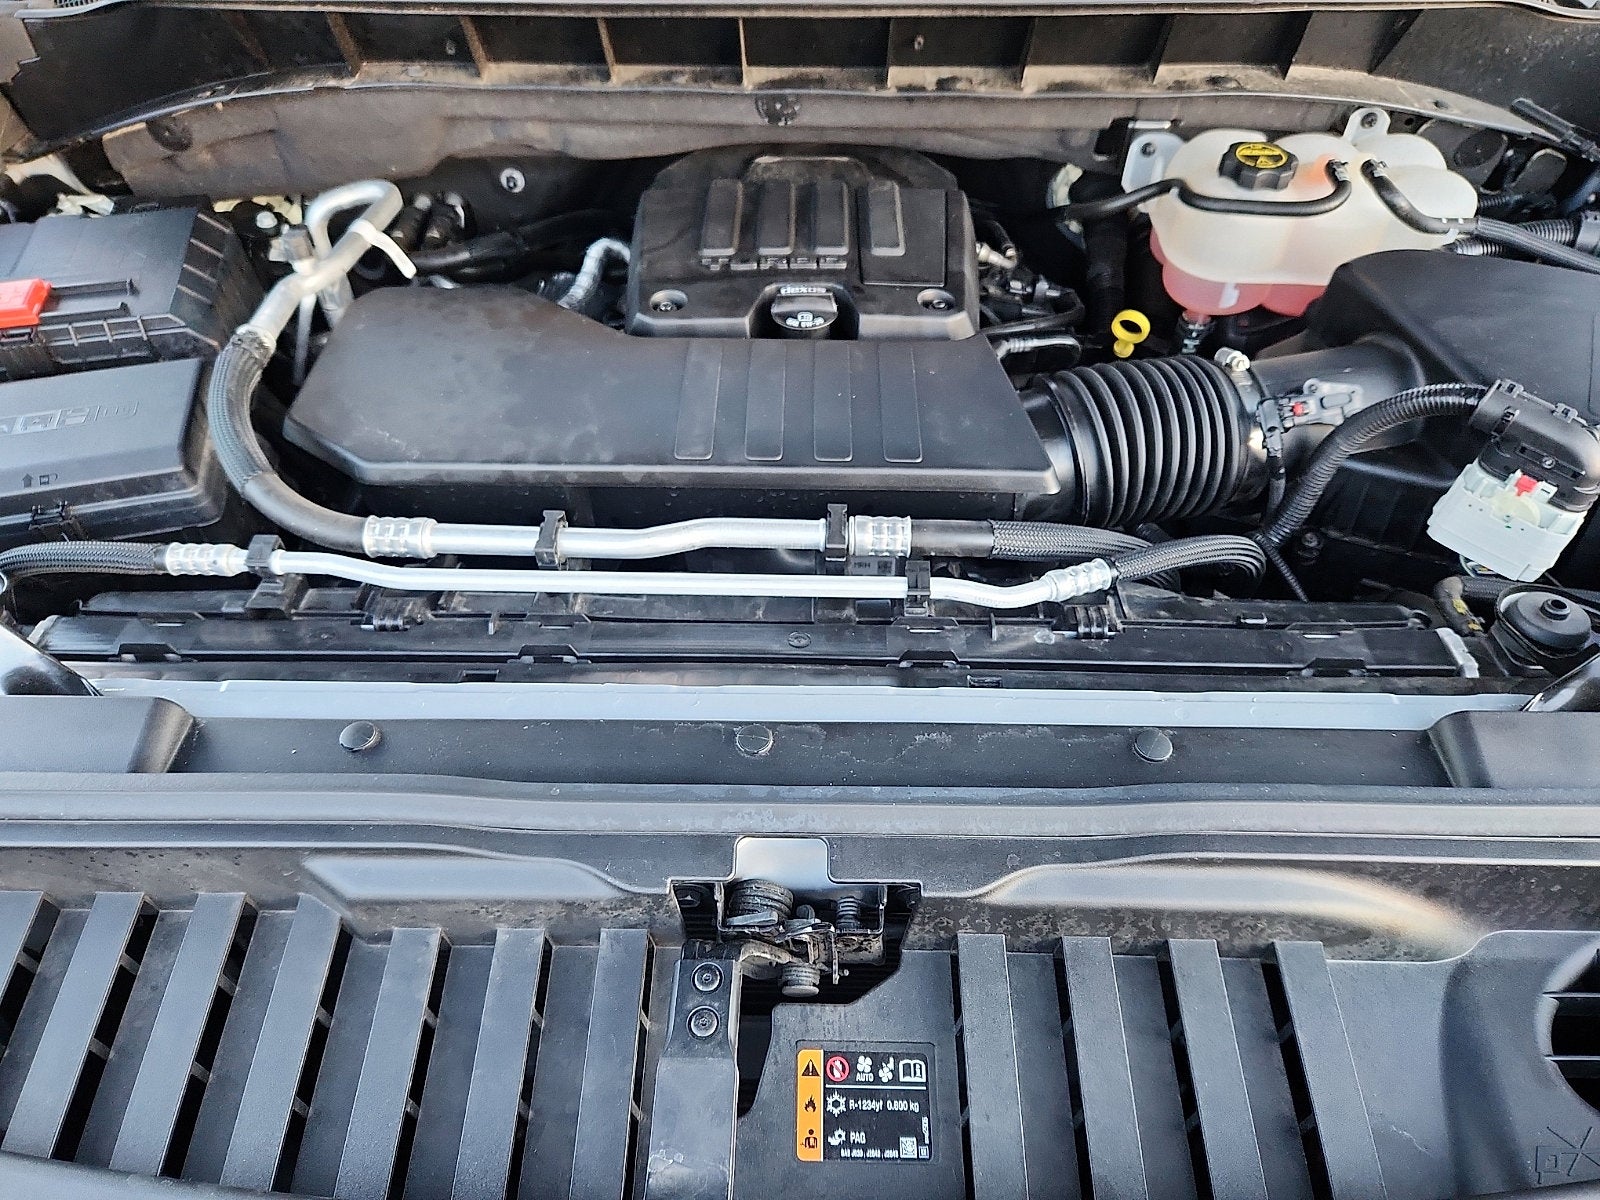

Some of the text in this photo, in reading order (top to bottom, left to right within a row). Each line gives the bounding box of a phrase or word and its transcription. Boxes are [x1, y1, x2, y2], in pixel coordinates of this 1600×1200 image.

[855, 1073, 874, 1082] AUTO
[849, 1099, 883, 1112] R-1234yf
[909, 1099, 920, 1113] kg
[849, 1131, 866, 1145] PAG
